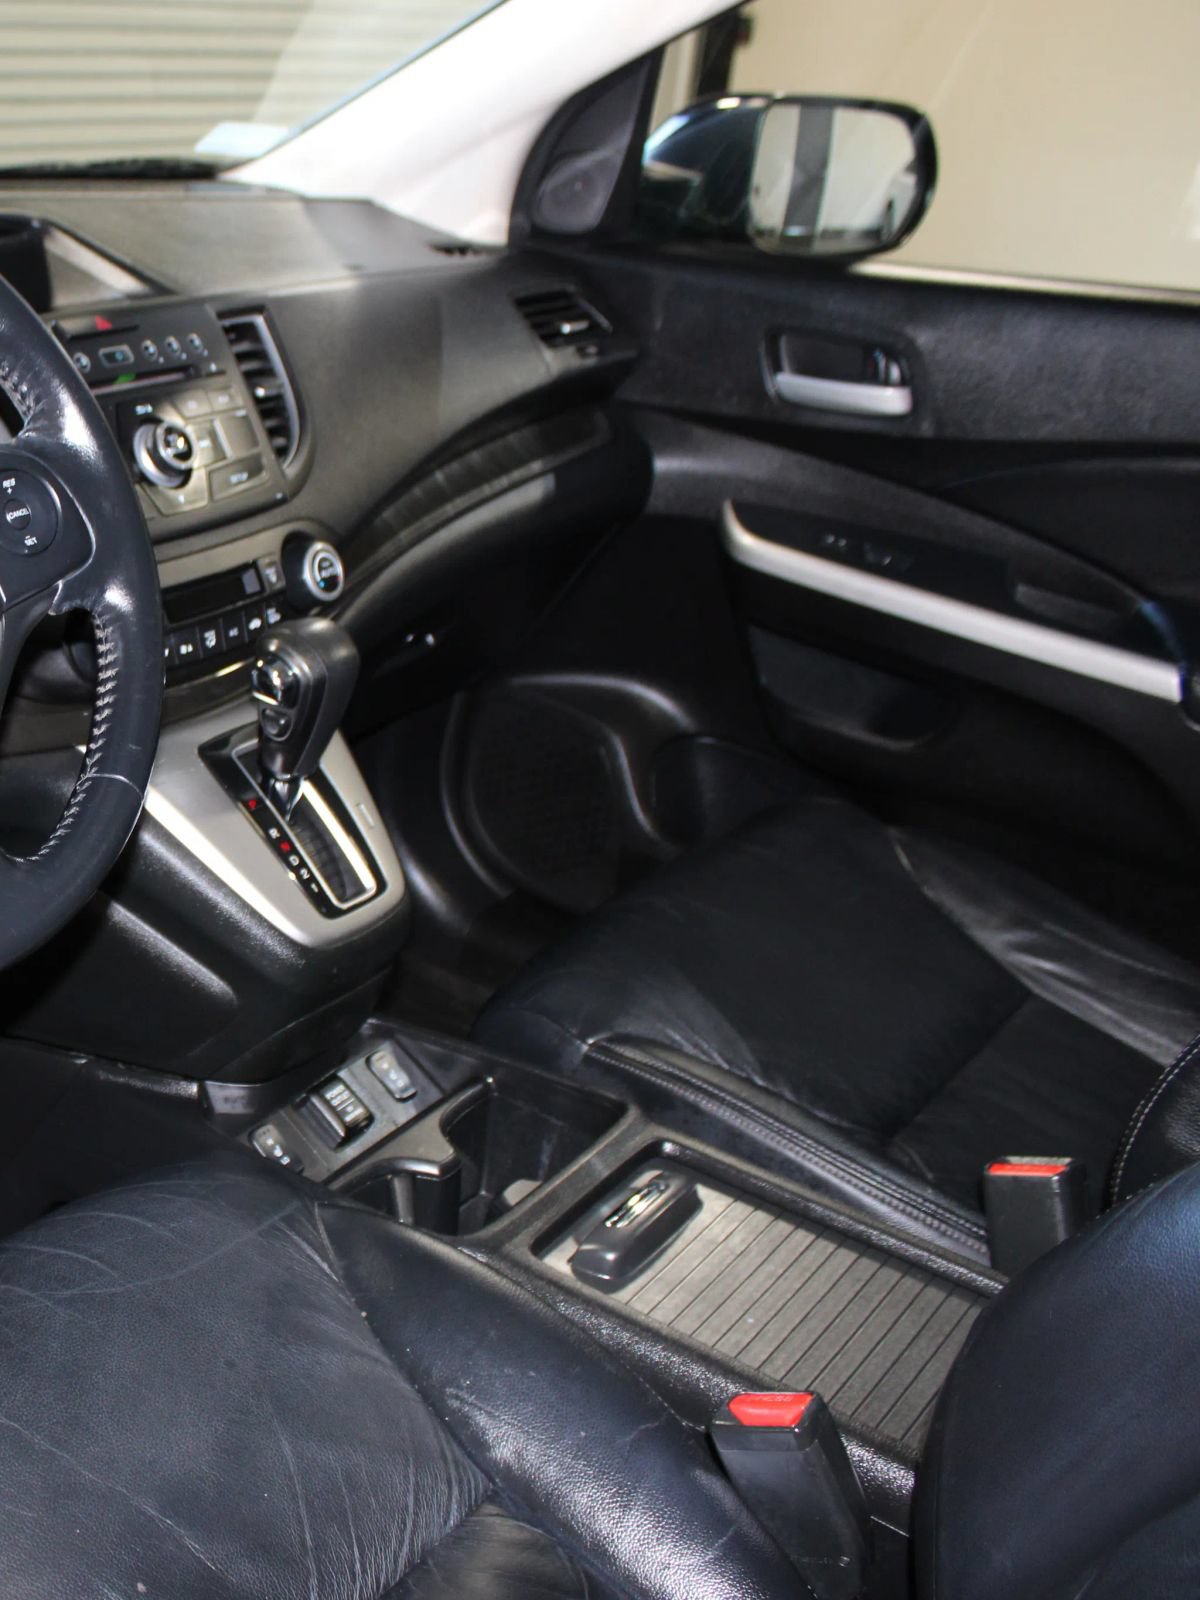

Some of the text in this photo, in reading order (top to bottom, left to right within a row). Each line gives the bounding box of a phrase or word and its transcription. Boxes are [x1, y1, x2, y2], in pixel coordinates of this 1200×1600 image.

[2, 478, 16, 488] RES
[7, 508, 30, 521] CANCEL
[24, 536, 38, 547] SET
[300, 868, 310, 880] 2
